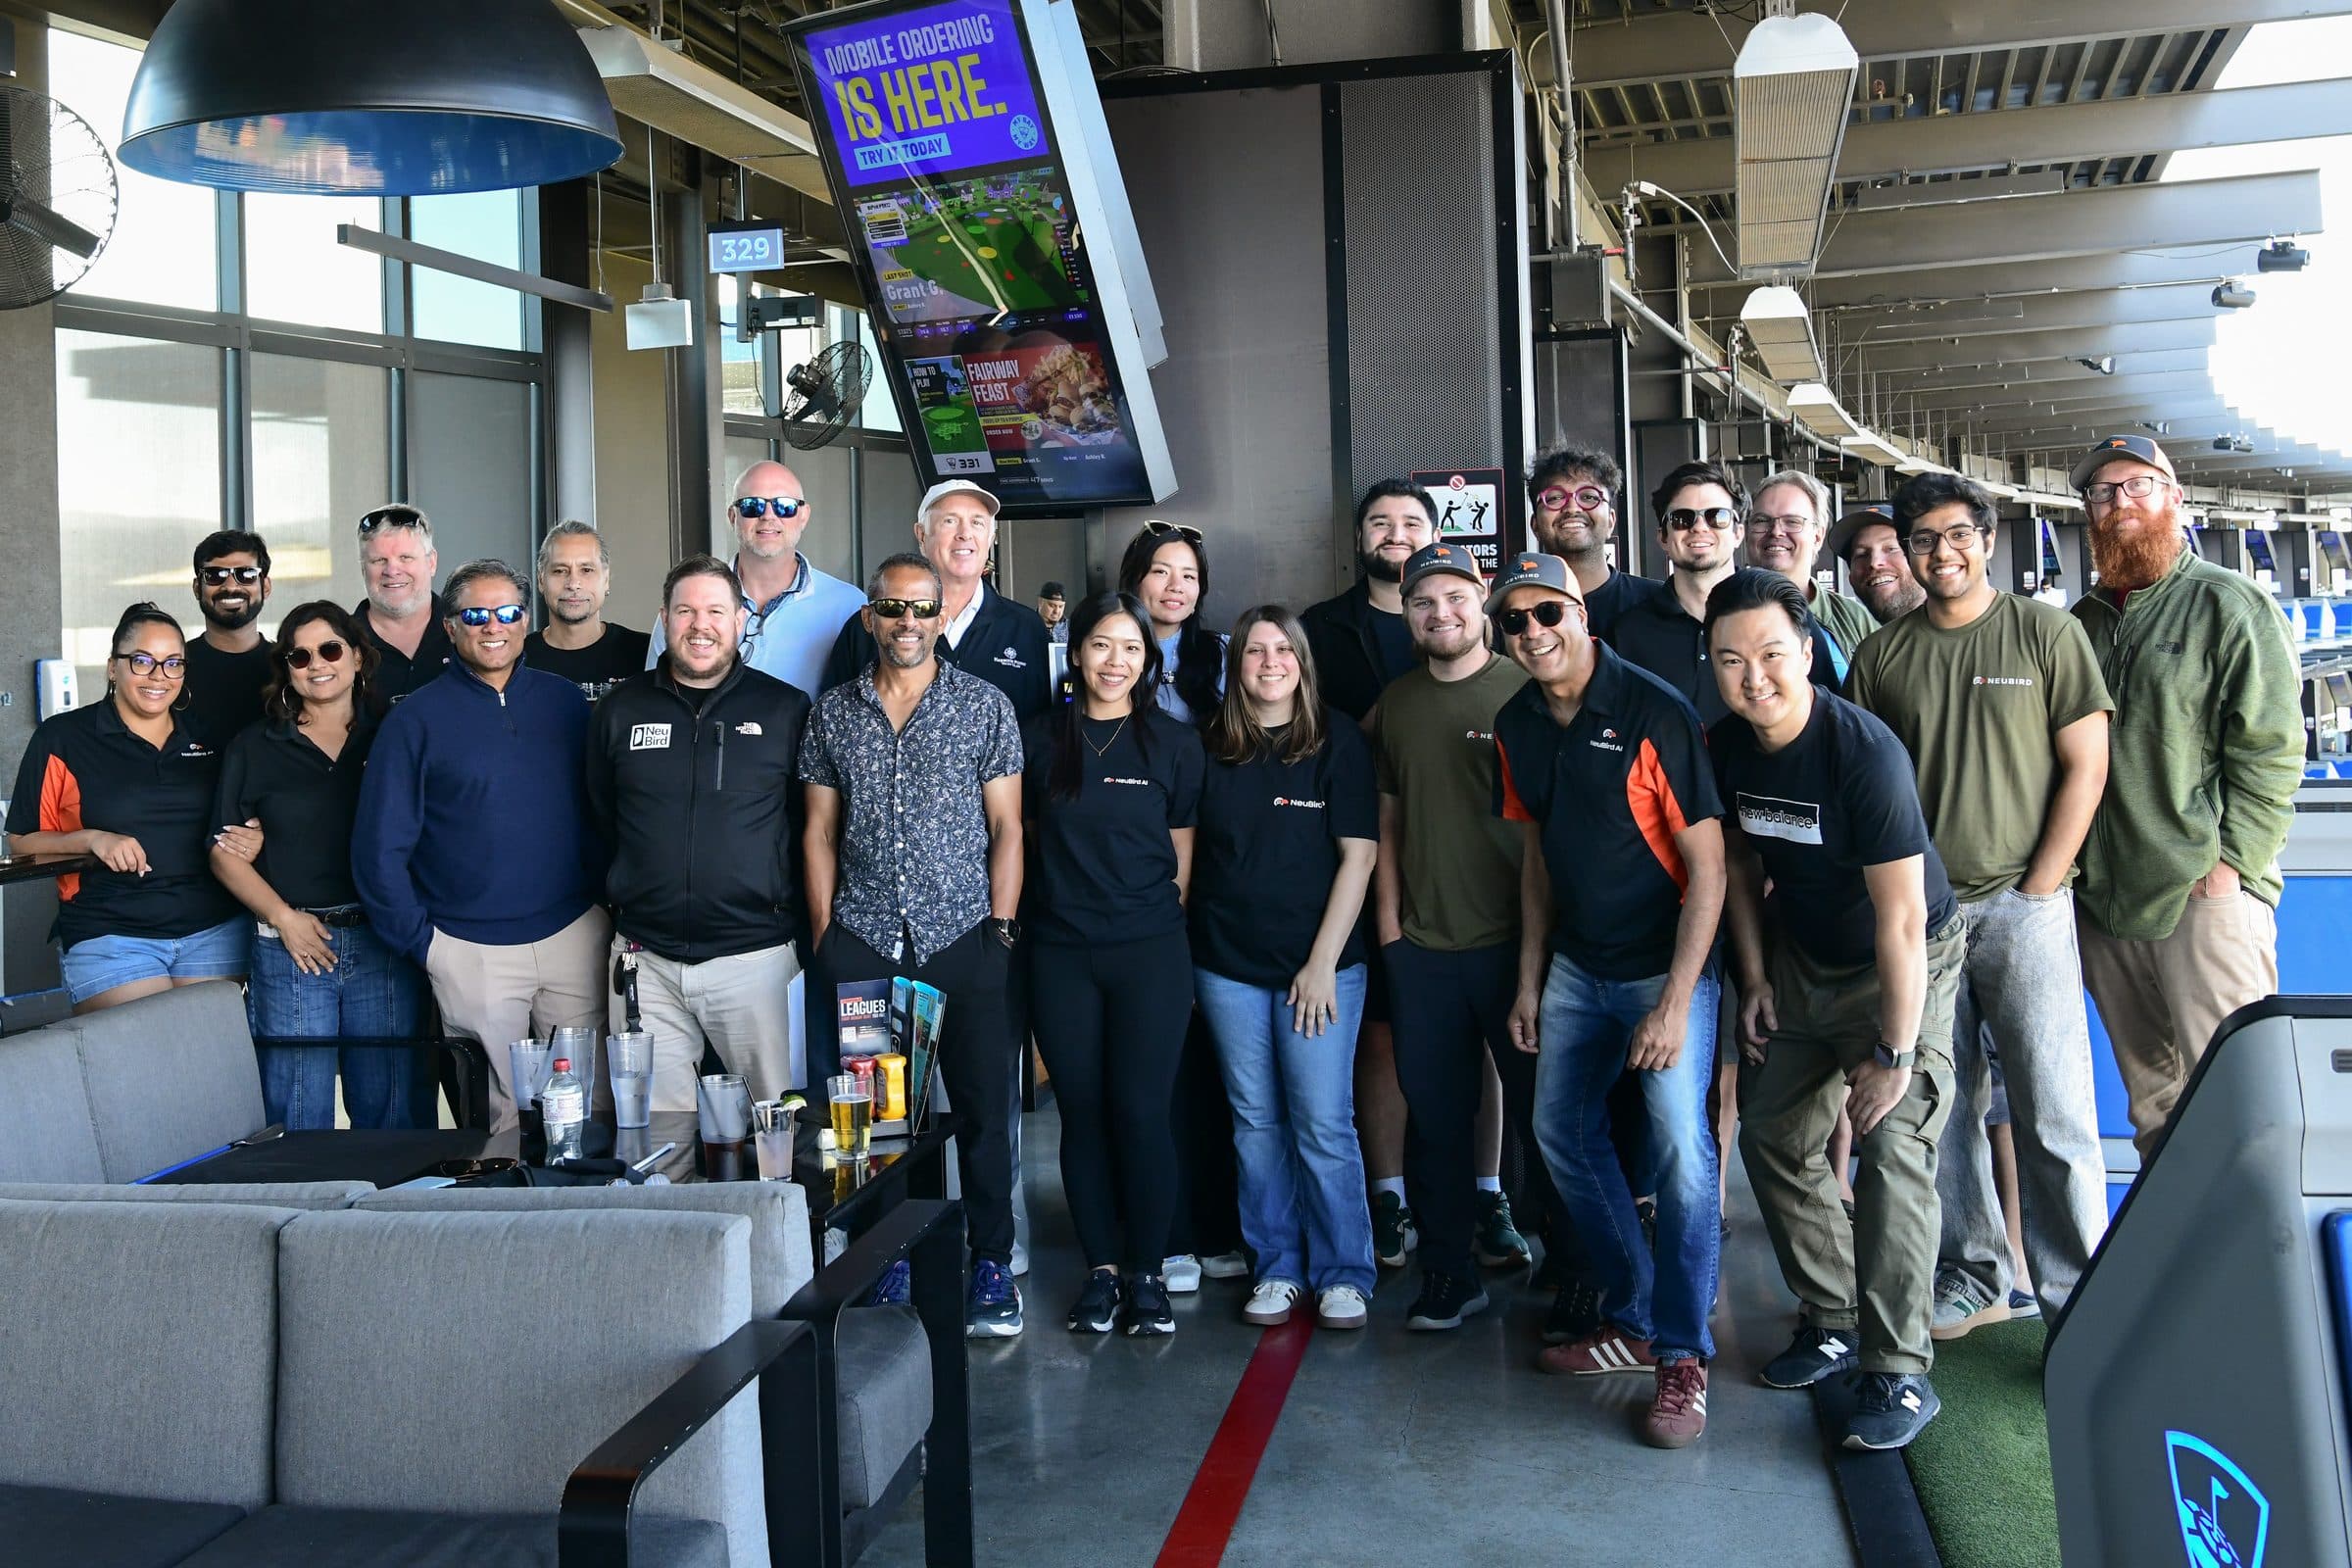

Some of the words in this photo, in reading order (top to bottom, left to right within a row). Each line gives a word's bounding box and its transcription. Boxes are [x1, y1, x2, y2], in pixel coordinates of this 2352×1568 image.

[824, 34, 898, 75] MOBILE
[898, 14, 995, 60] ORDERING
[835, 76, 882, 141] IS
[880, 54, 1007, 133] HERE.
[859, 149, 883, 165] TRY
[888, 146, 899, 161] IT
[902, 138, 943, 158] TODAY
[721, 237, 769, 263] 329
[886, 282, 927, 300] Grant
[912, 368, 927, 377] HOW
[927, 367, 936, 375] TO
[966, 360, 1019, 381] FAIRWAY
[916, 378, 930, 388] PLAY
[973, 382, 1010, 403] FEAST
[959, 458, 980, 469] 331
[1481, 558, 1498, 568] THE
[1987, 677, 2033, 686] NEUBIRD
[646, 726, 668, 735] Neu
[646, 736, 667, 746] Bird
[1740, 806, 1764, 820] new
[1765, 808, 1813, 828] balance
[841, 1000, 886, 1016] LEAGUES
